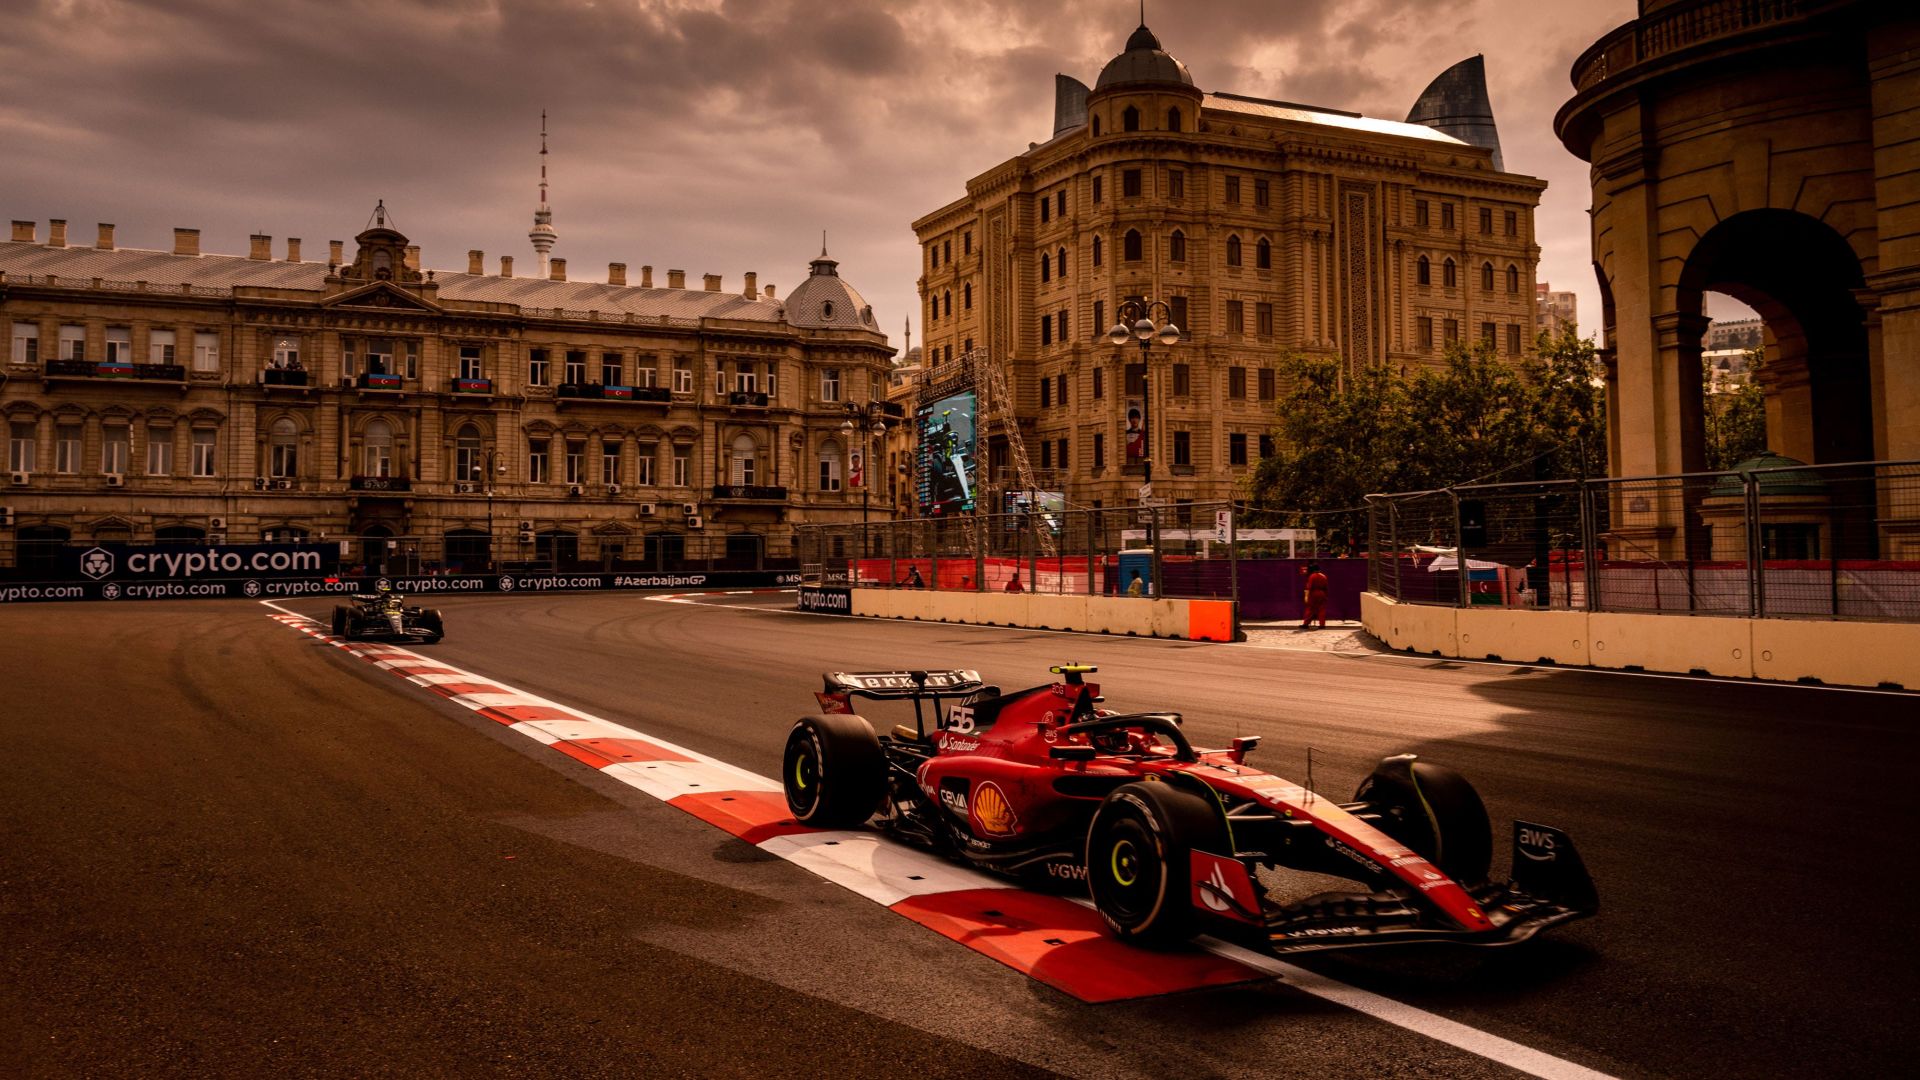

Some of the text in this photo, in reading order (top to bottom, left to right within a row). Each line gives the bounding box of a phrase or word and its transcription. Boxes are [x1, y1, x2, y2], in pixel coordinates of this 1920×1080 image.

[127, 549, 321, 576] crypto.com
[266, 578, 359, 594] crypto.com
[395, 577, 484, 592] crypto.com
[519, 576, 601, 592] crypto.com
[613, 575, 706, 587] #AzerbaijanGP
[126, 582, 226, 598] crypto.com
[803, 590, 847, 610] crypto.com
[947, 705, 975, 734] 55
[947, 736, 981, 751] Santander
[1519, 828, 1555, 849] aws
